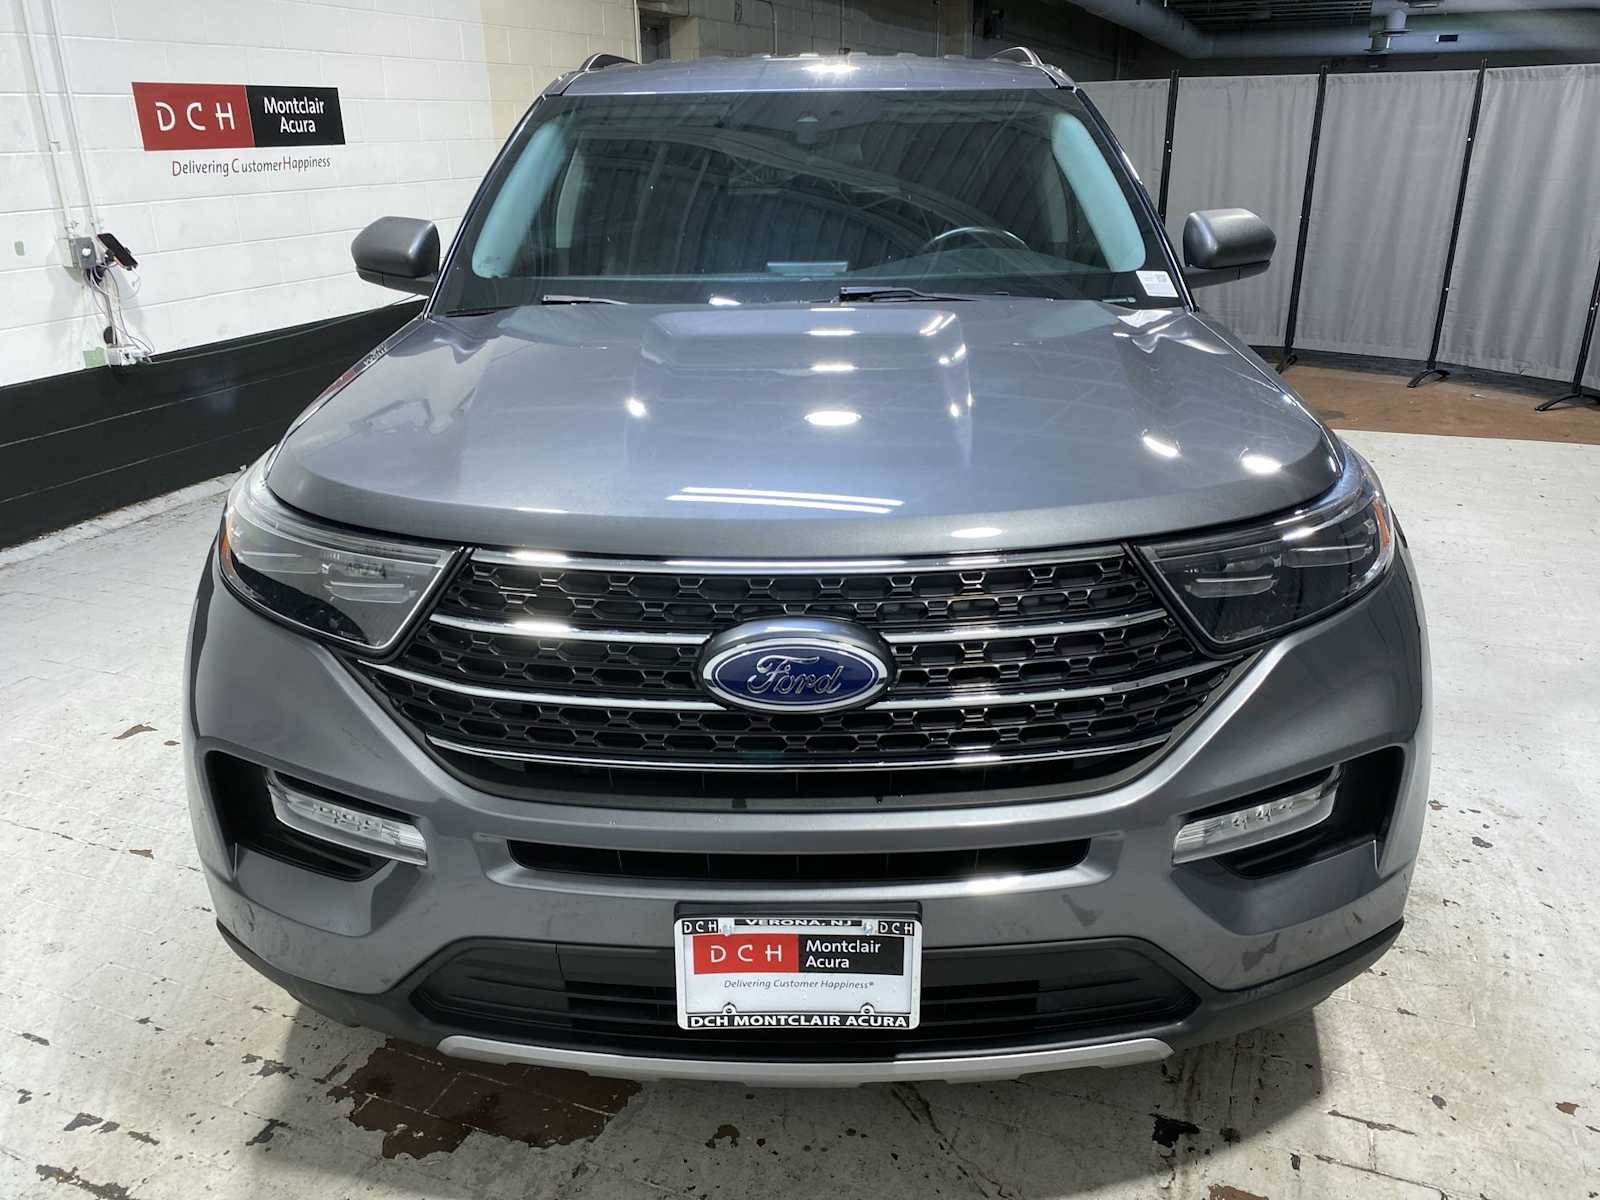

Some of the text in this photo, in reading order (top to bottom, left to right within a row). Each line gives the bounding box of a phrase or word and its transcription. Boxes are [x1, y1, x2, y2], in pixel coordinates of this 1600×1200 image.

[264, 97, 324, 115] Montclair
[280, 117, 316, 134] Acura
[172, 160, 229, 177] Delivering
[746, 654, 844, 695] Ford
[683, 920, 718, 934] DCH
[830, 919, 852, 927] NJ
[879, 922, 914, 935] DCH
[805, 939, 881, 954] Montclair
[710, 944, 783, 964] DCH
[805, 956, 850, 969] Acura
[723, 979, 771, 990] Delivering
[773, 979, 819, 989] Customer
[690, 1015, 908, 1028] DCH MONTCLAIR ACURA
